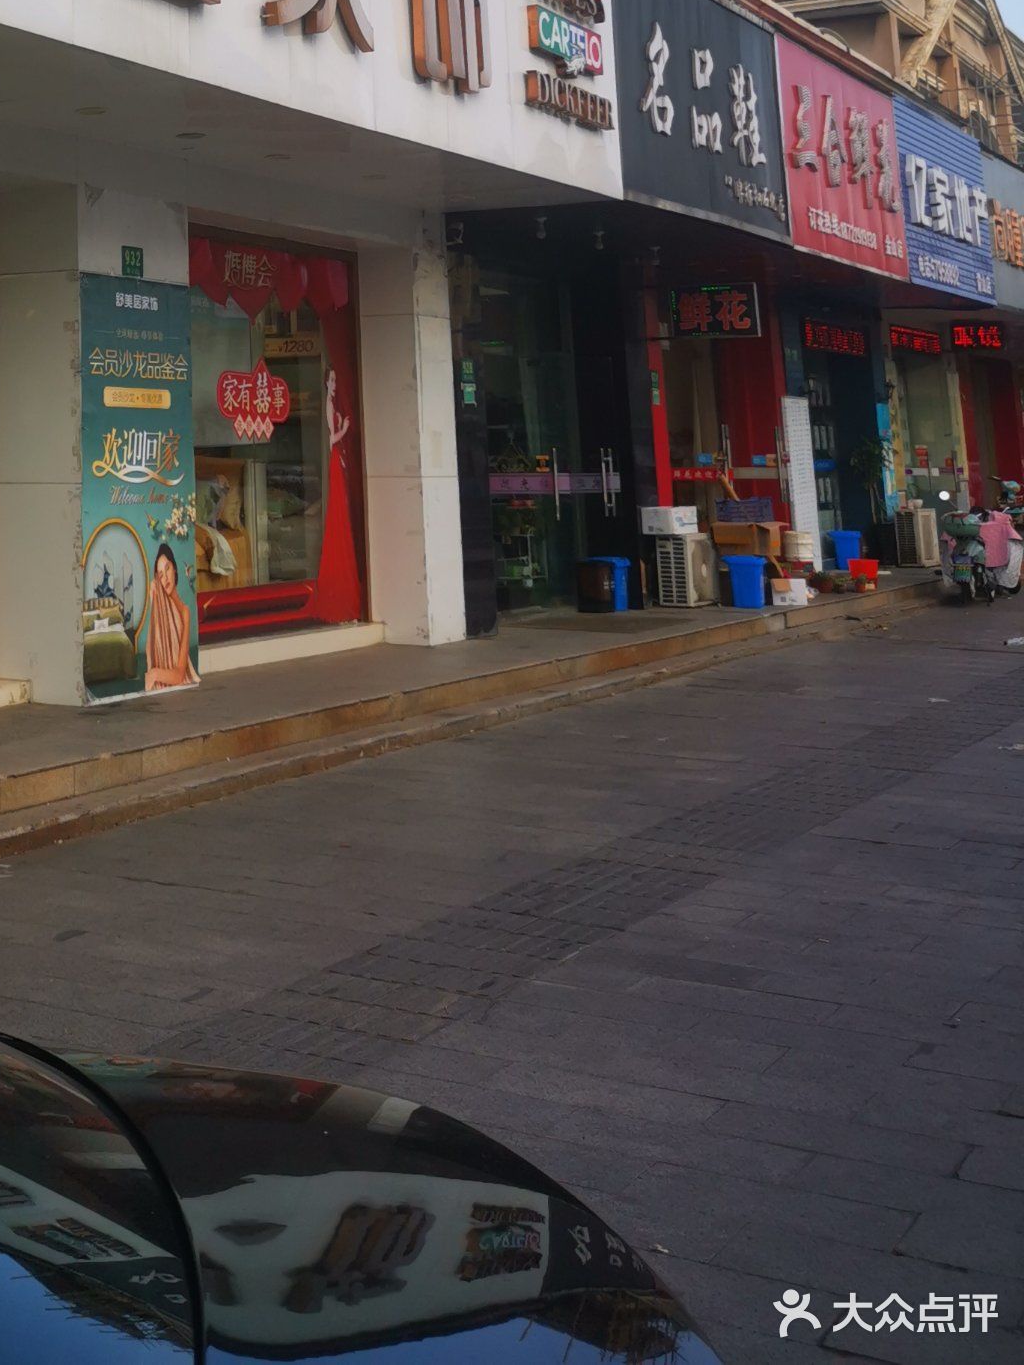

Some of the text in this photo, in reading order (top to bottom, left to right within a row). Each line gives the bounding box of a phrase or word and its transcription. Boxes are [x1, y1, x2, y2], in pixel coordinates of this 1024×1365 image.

[537, 10, 603, 70] CARTELO
[640, 21, 767, 167] 名品鞋
[905, 154, 989, 246] 亿家地产
[124, 250, 141, 267] 932
[223, 249, 278, 290] 婚博会
[115, 291, 159, 312] 舒美居家饰
[679, 290, 752, 332] 鲜花
[88, 346, 189, 381] 会员沙龙品鉴会
[97, 426, 182, 481] 欢迎回家
